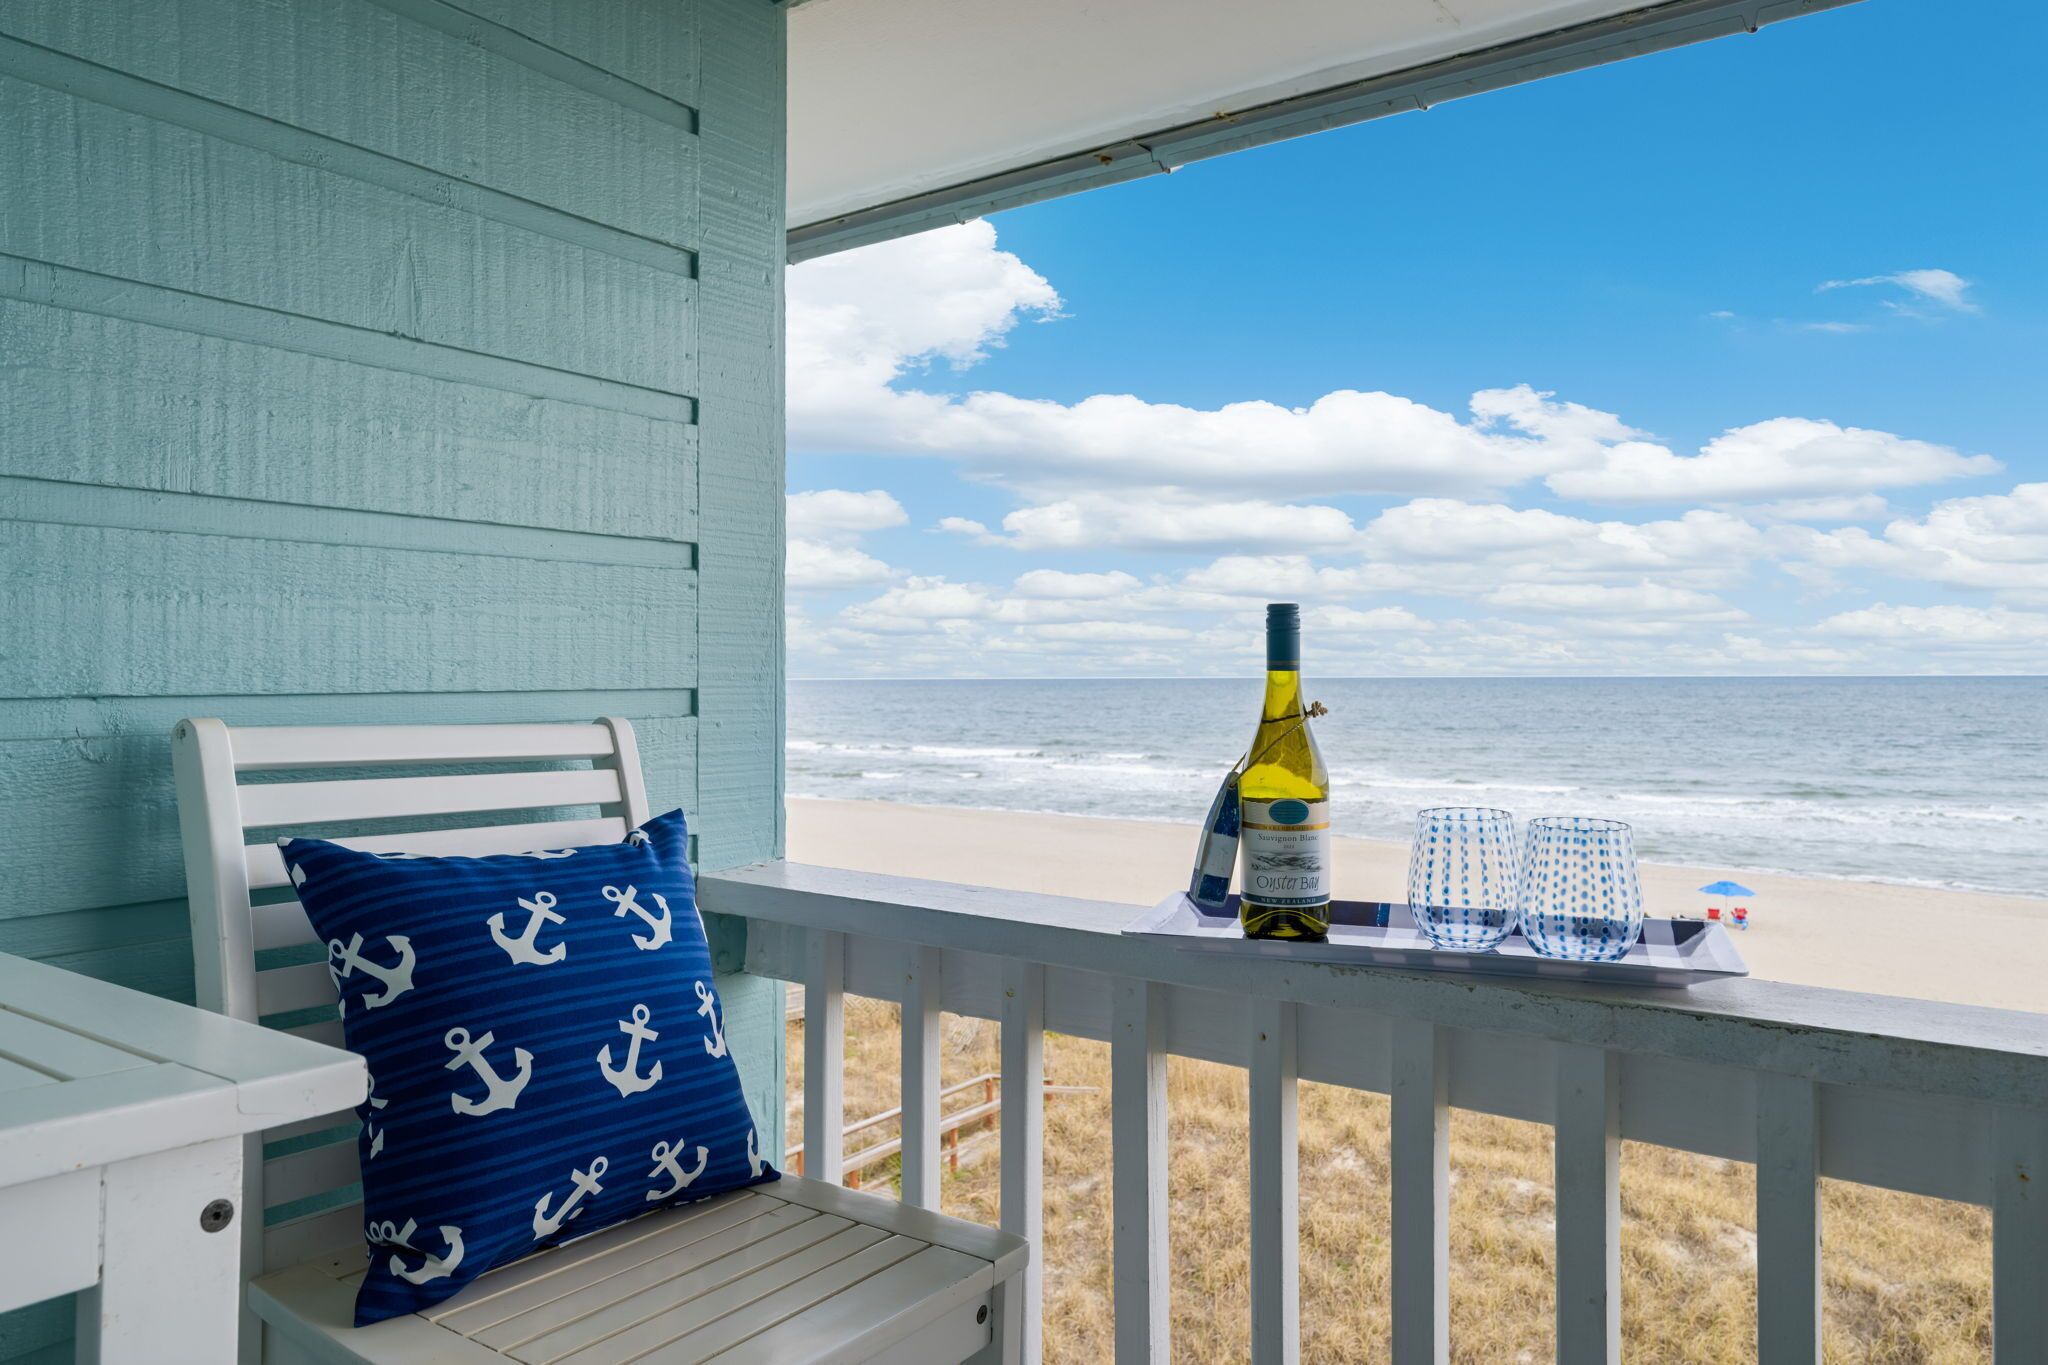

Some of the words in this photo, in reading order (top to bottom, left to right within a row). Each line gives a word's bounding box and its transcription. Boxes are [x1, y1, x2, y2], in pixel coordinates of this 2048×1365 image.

[1258, 834, 1297, 843] Sauvignon
[1299, 833, 1319, 842] Blanc
[1256, 875, 1298, 891] Oyster
[1300, 876, 1319, 891] Bay
